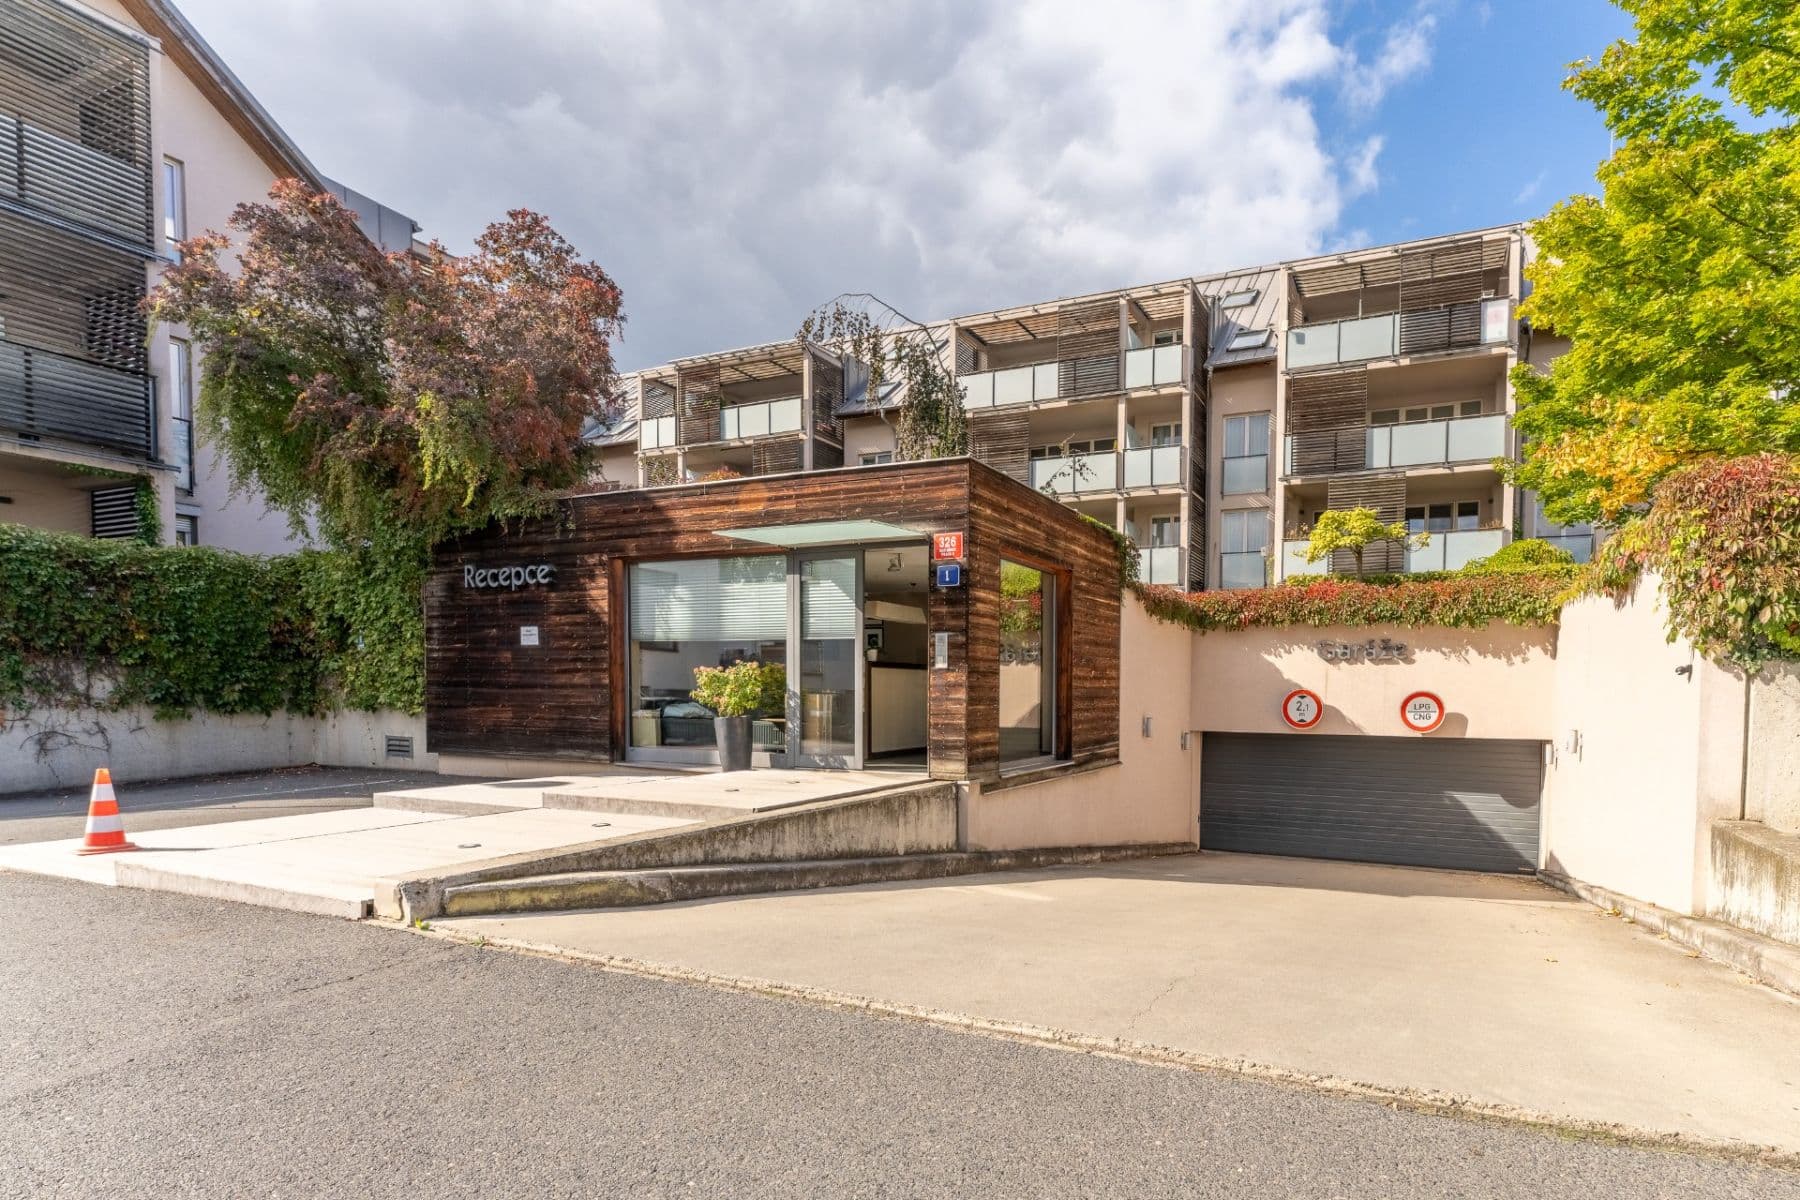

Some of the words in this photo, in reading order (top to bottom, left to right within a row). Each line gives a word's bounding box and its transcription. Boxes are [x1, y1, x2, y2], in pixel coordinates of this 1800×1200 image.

[938, 536, 957, 548] 326
[464, 564, 550, 591] Recepce
[945, 570, 949, 581] 1
[1318, 639, 1408, 660] Garáže
[1413, 713, 1431, 721] CNG
